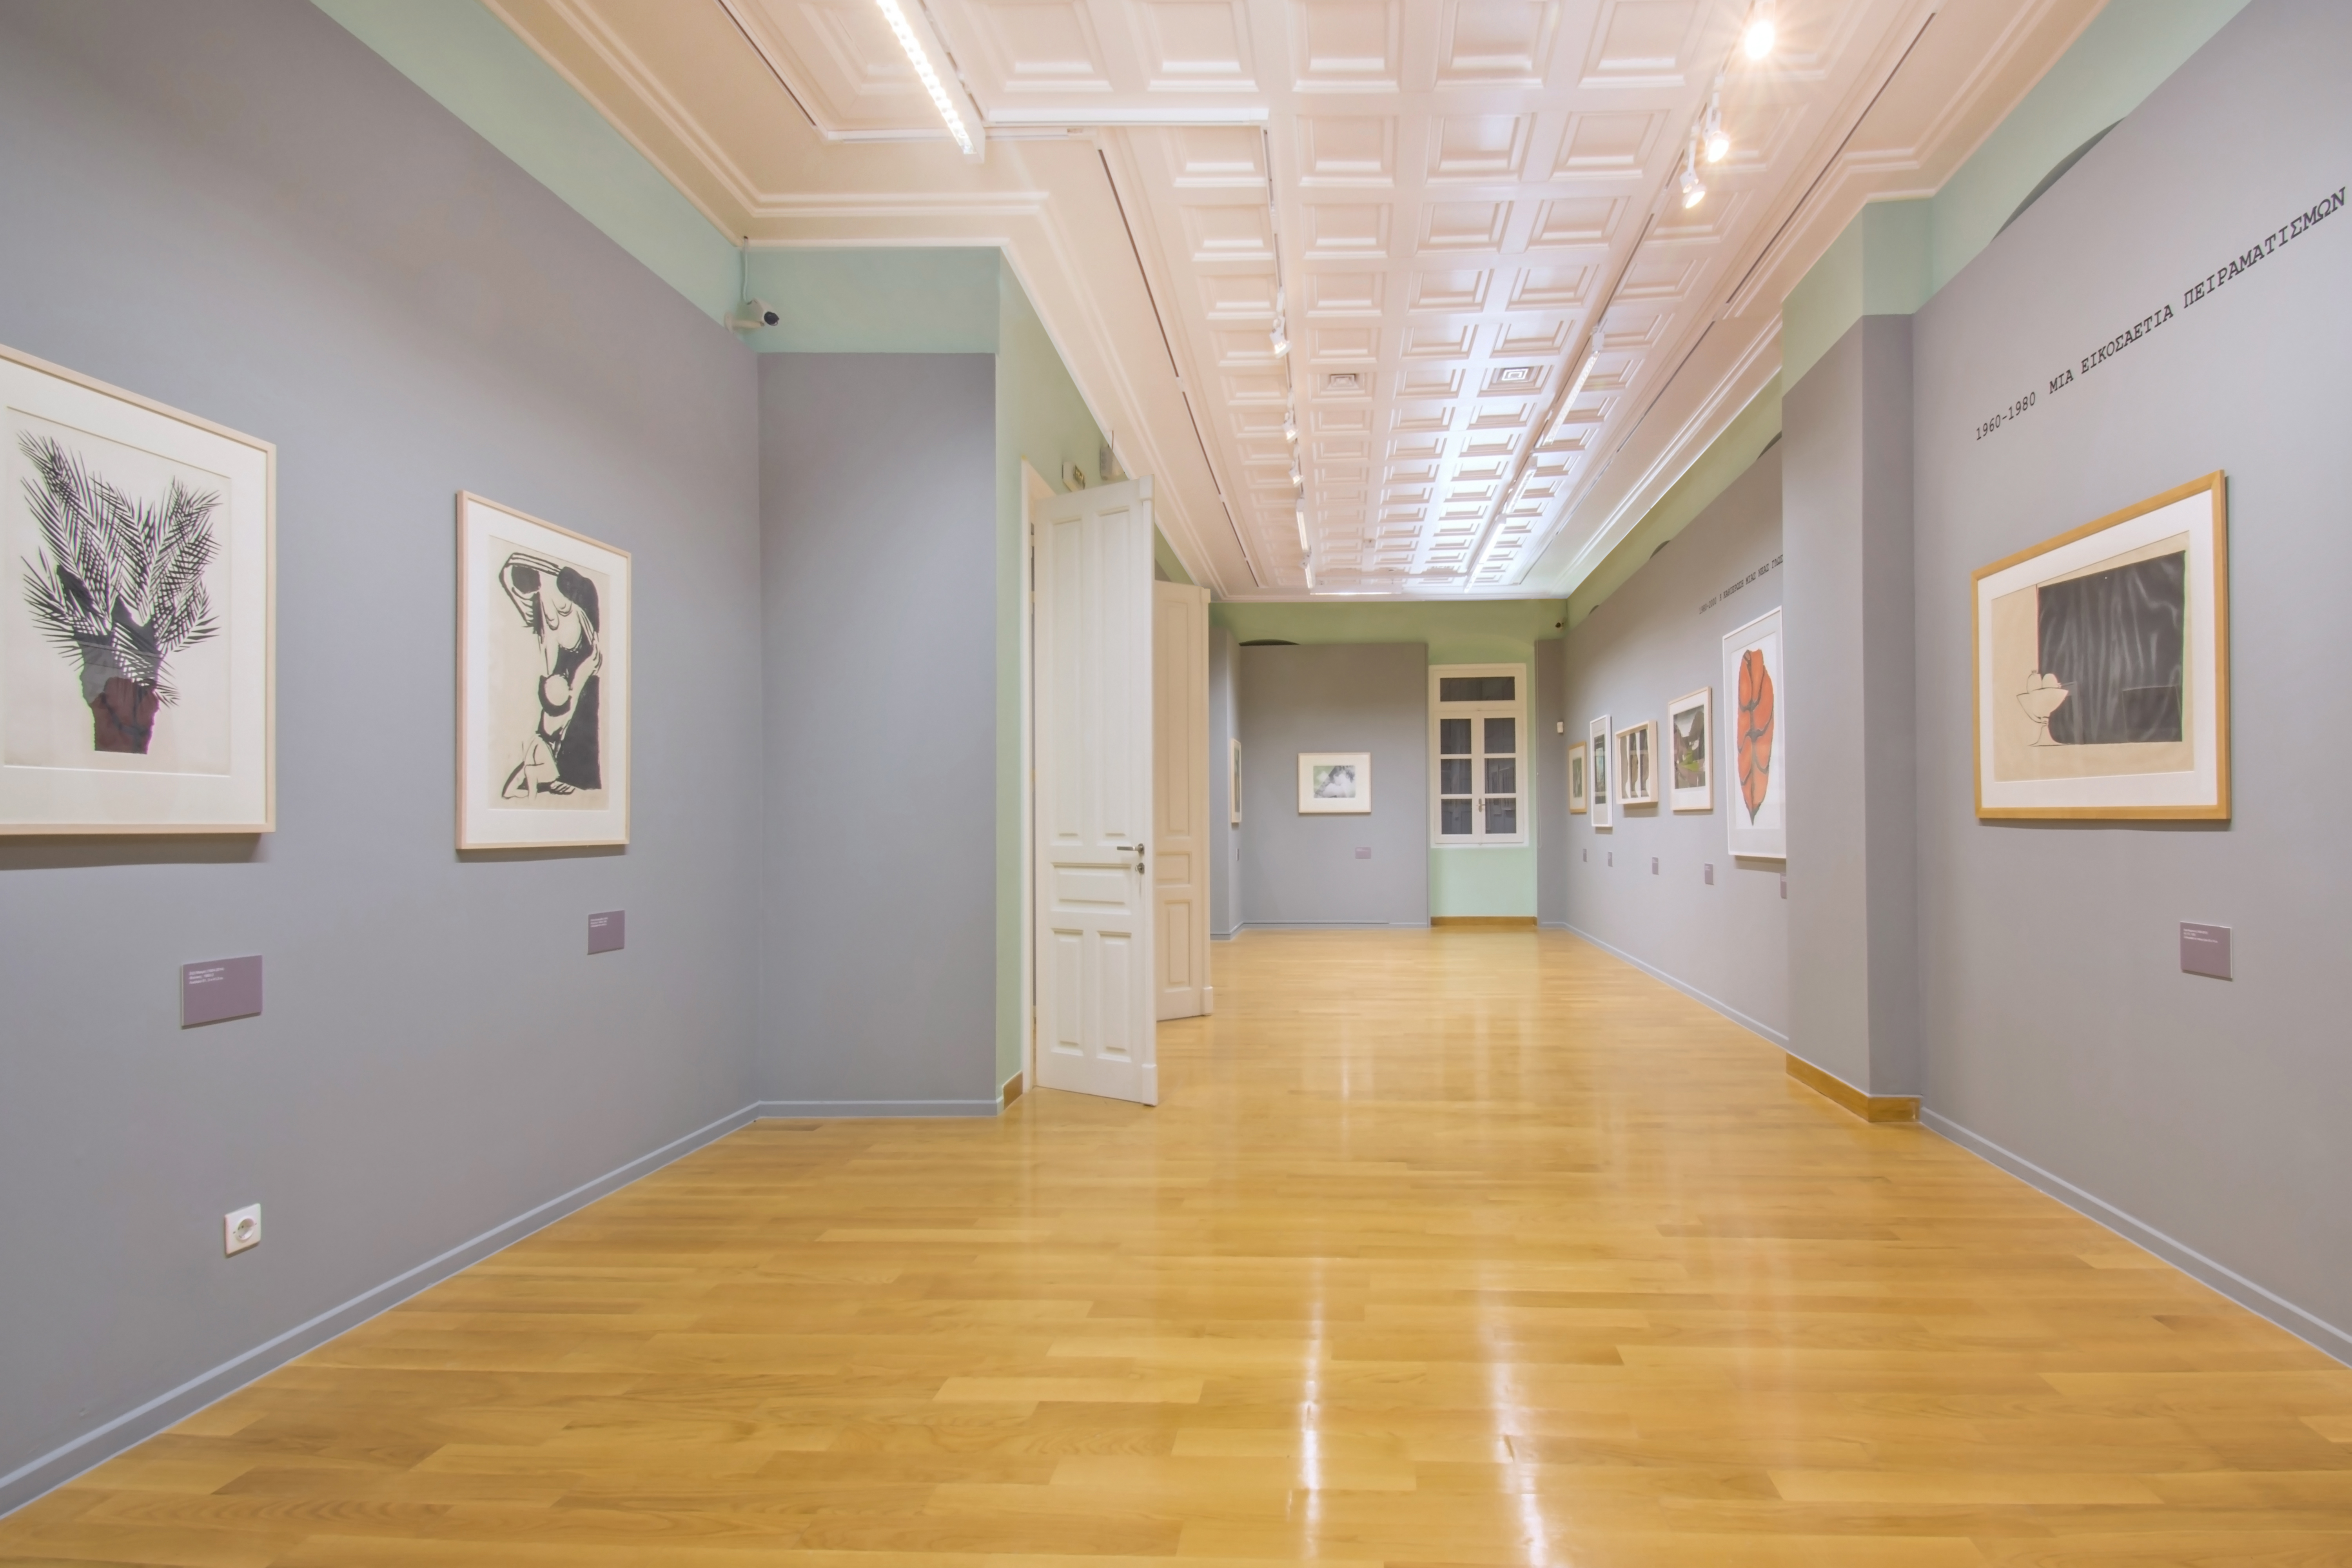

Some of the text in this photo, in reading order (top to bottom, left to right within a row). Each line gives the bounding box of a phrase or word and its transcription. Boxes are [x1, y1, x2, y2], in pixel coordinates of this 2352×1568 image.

[1976, 186, 2346, 441] 1960-1980 ΜΙΑ ΕΙΚΟΣΑΕΤΙΑ ΠΕΙΡΑΜΑΤΙΣΜΩΝ
